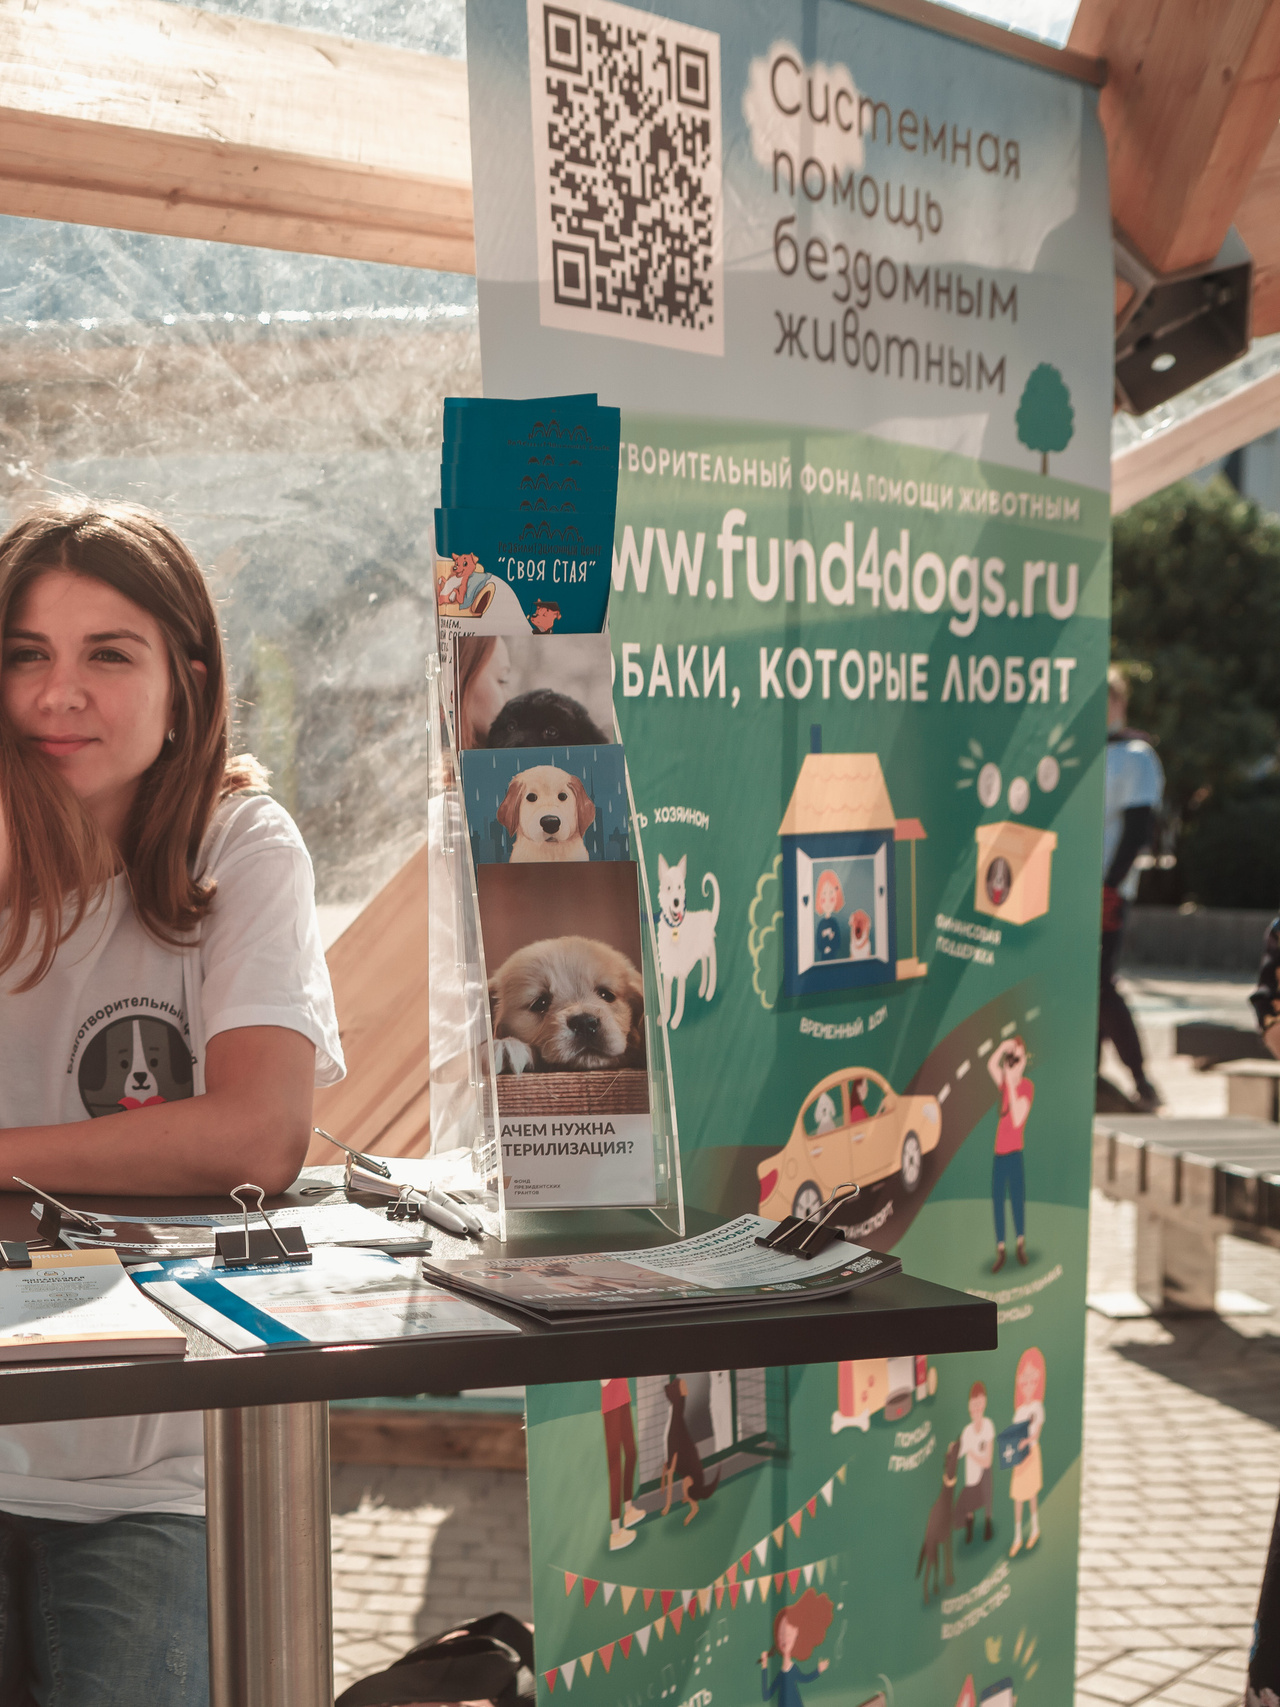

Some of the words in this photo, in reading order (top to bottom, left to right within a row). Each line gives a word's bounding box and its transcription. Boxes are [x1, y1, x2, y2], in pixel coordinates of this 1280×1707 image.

[769, 53, 1022, 182] Системная
[771, 145, 944, 243] помощь
[773, 215, 1020, 325] бездомным
[773, 307, 1008, 396] животным
[799, 463, 863, 502] ФОНД
[866, 475, 954, 511] ПОМОЩИ
[956, 486, 1081, 522] ЖИВОТНЫМ
[611, 640, 741, 709] БАКИ,
[758, 645, 929, 702] КОТОРЫЕ
[939, 653, 1078, 704] ЛЮБЯТ
[653, 805, 710, 831] ХОЗЯИНОМ
[799, 1016, 864, 1040] ВРЕМЕННЫЙ
[489, 1123, 547, 1138] АЧЕМ
[551, 1121, 616, 1137] НУЖНА
[499, 1140, 634, 1157] ТЕРИЛИЗАЦИЯ?
[684, 1217, 752, 1246] ПОМОЩИ
